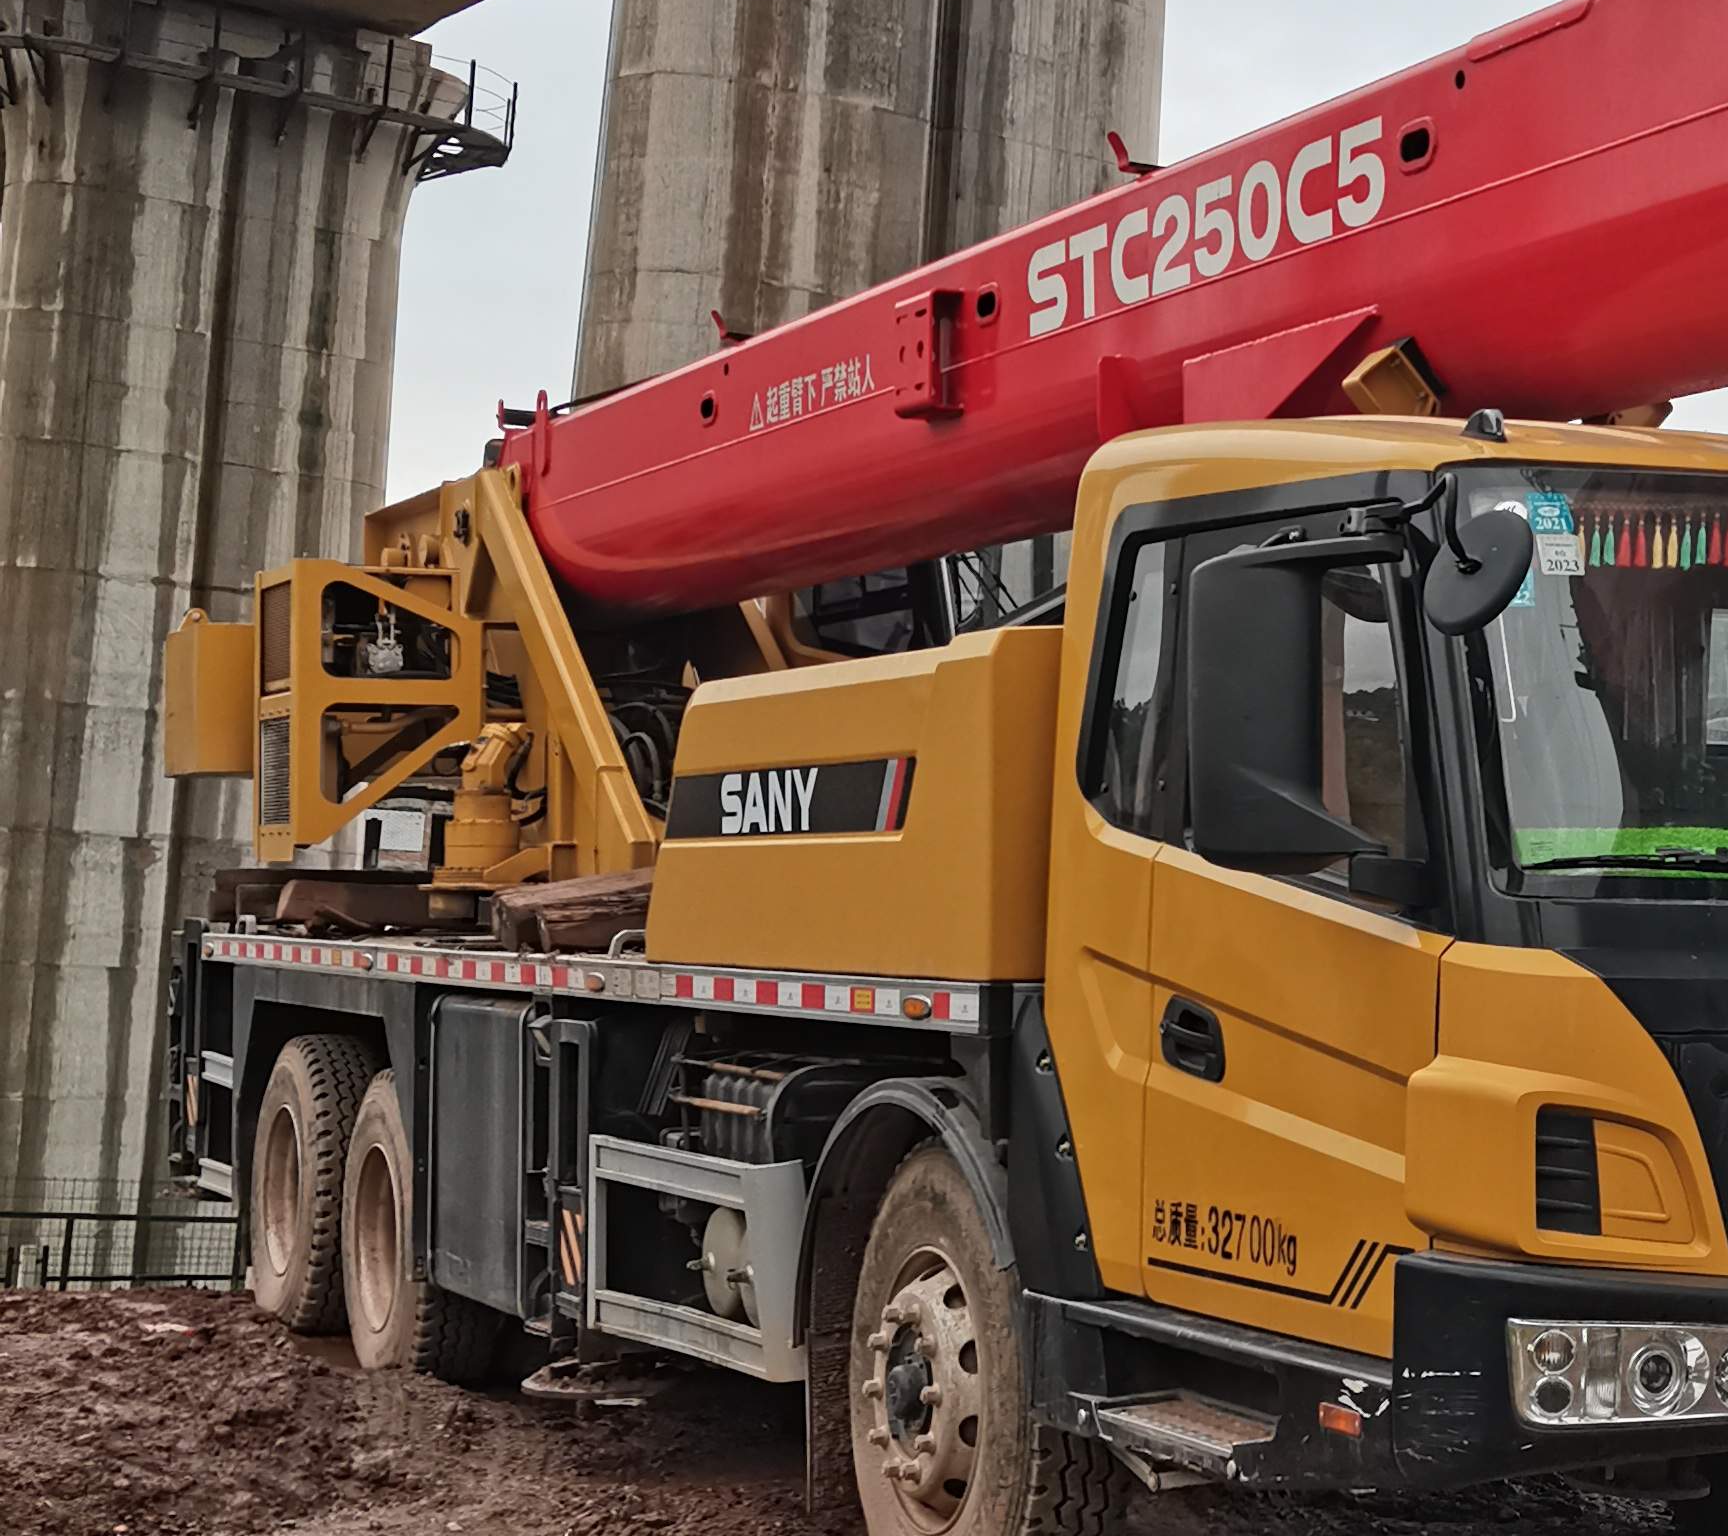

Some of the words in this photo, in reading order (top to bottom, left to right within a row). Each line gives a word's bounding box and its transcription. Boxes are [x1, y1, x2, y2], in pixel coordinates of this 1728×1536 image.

[1027, 116, 1386, 337] STC250C5
[766, 373, 817, 424] 起重臂下
[820, 353, 876, 407] 严禁站人
[1534, 517, 1568, 530] 2021
[1546, 559, 1580, 573] 2023
[720, 767, 819, 835] SANY
